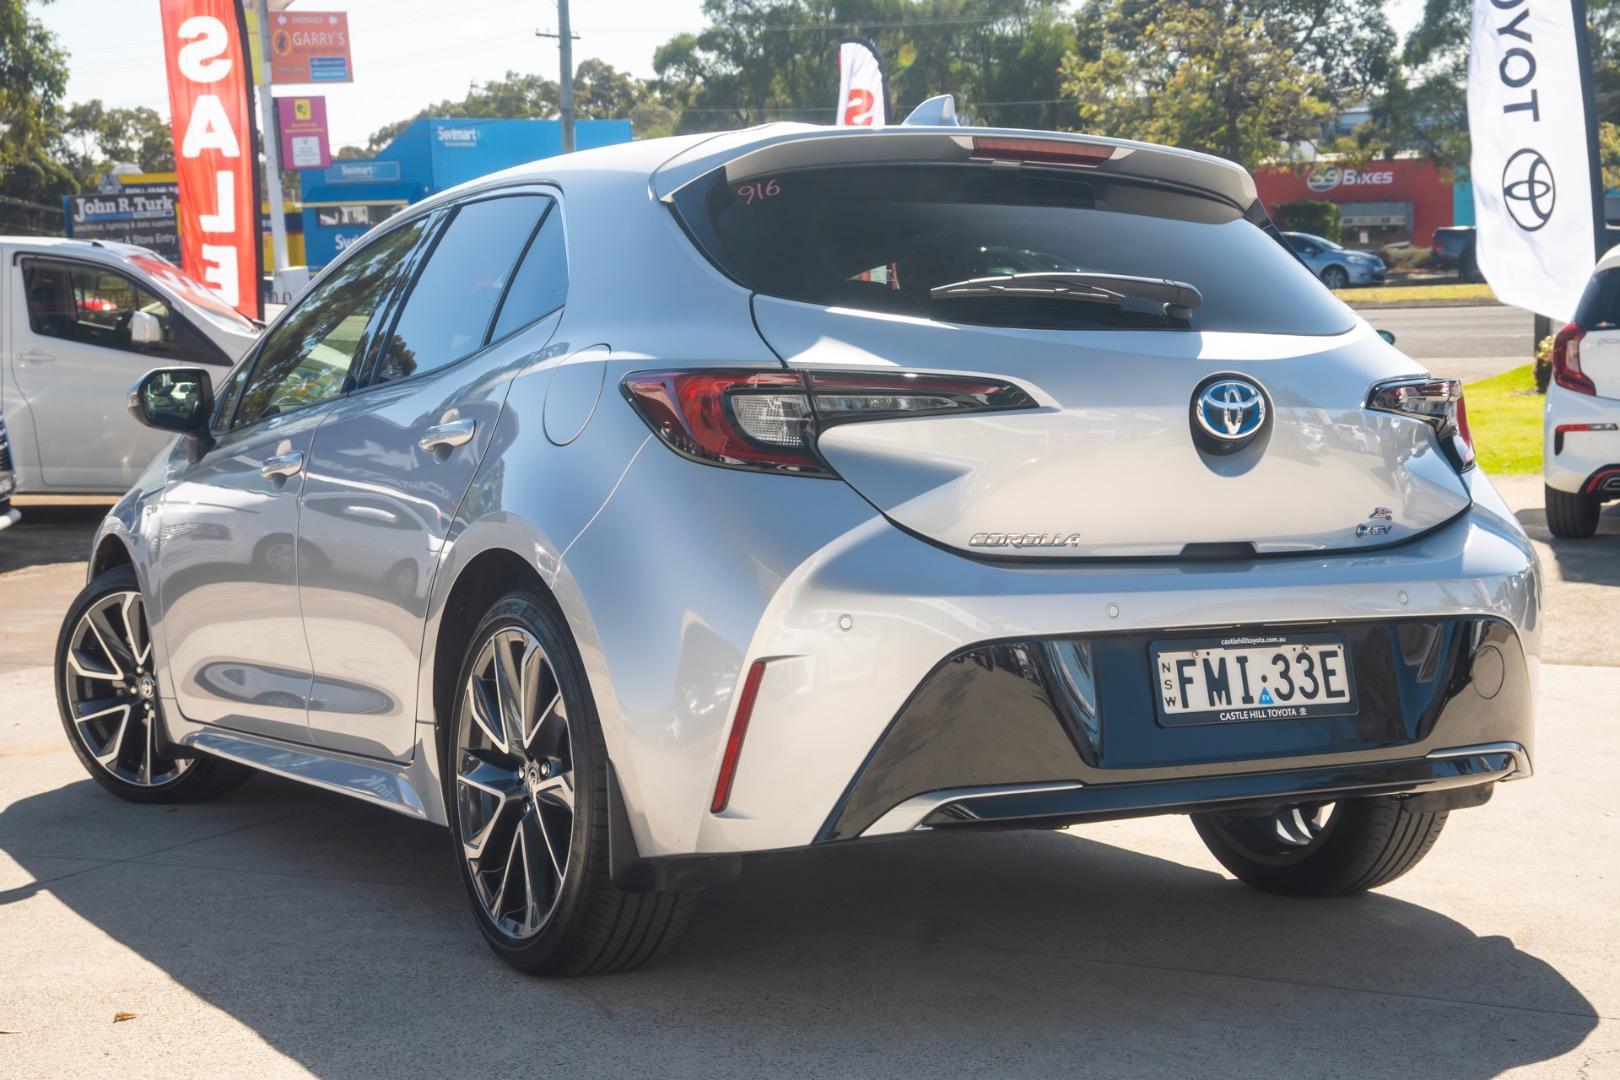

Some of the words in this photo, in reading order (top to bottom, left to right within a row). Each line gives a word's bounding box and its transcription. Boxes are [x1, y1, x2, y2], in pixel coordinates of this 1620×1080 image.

[292, 31, 345, 47] GARRY'S
[437, 126, 477, 142] Swimart
[738, 179, 781, 205] 916
[74, 198, 117, 223] John
[969, 532, 1080, 549] COROLLA
[1221, 636, 1286, 646] castlehilltoyota.com.au
[1219, 710, 1249, 721] CASTLE
[1250, 709, 1265, 719] HILL
[1267, 708, 1297, 718] TOYOTA
